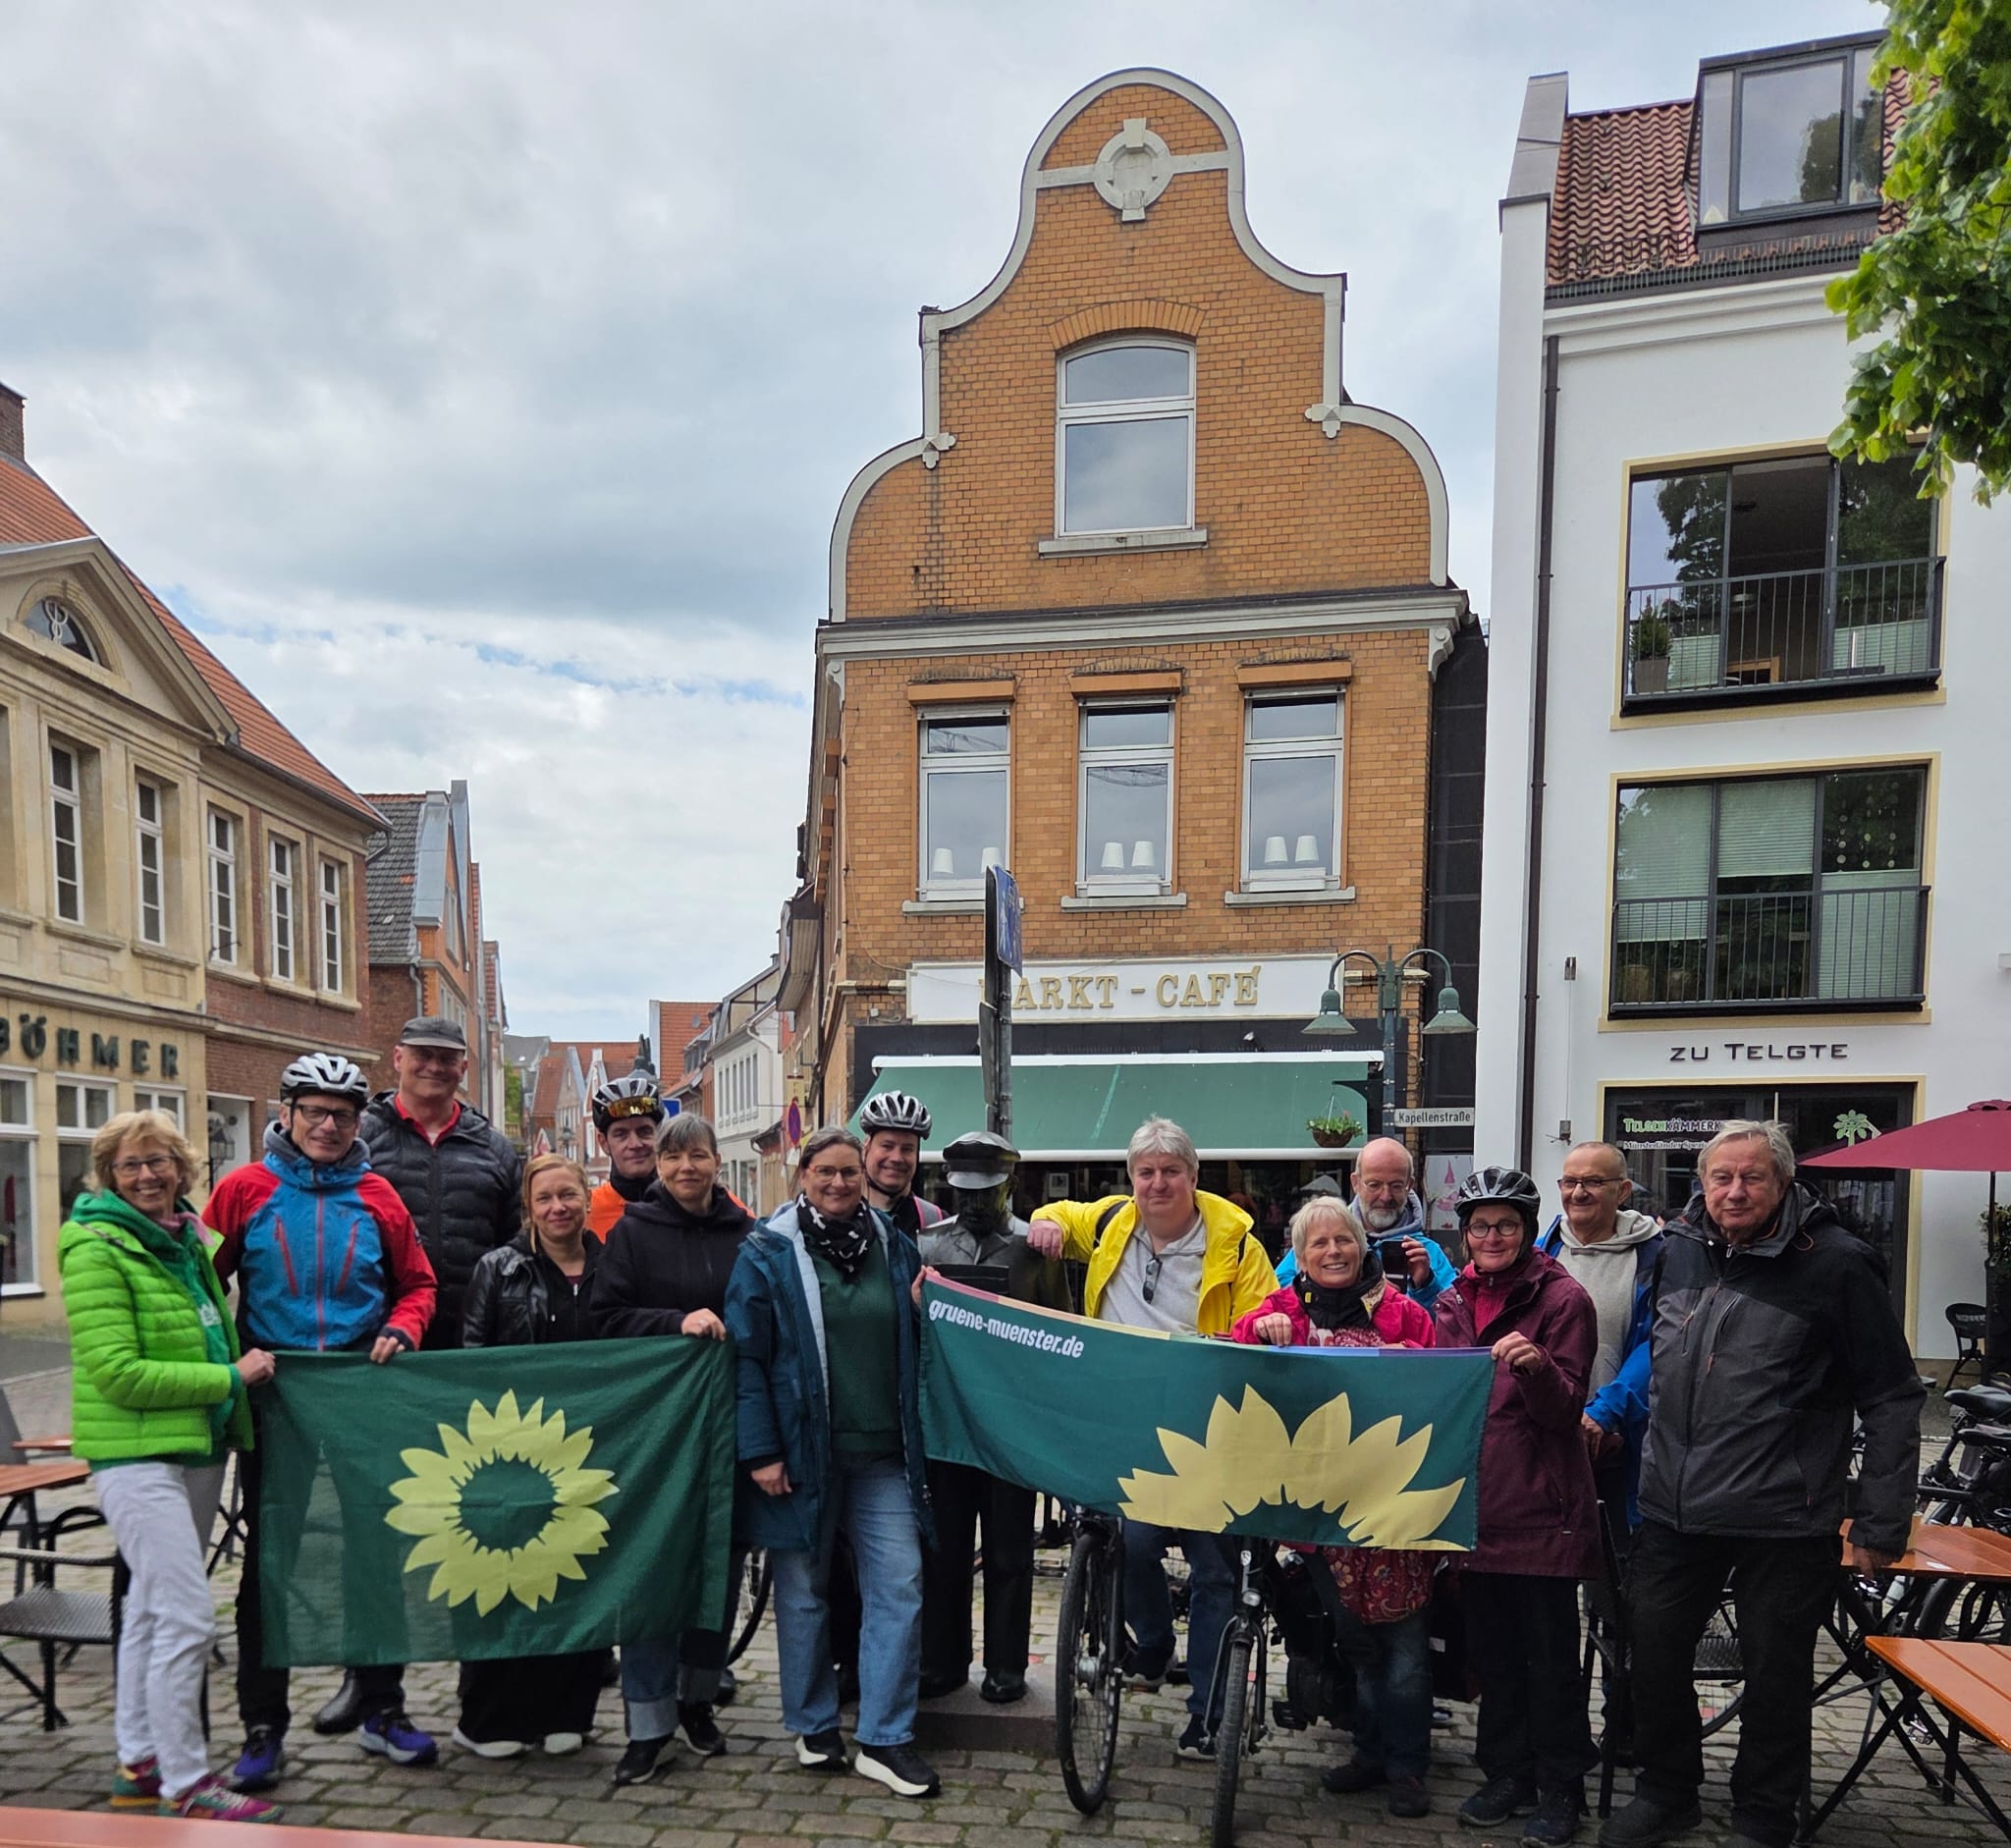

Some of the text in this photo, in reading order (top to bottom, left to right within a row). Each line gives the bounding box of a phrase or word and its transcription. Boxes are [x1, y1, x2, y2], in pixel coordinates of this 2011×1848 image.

[978, 975, 1117, 1009] ARKT
[1156, 965, 1261, 1006] CAFÉ
[1724, 1043, 1848, 1060] TELGTE
[1398, 1111, 1471, 1125] Kapellenstraße
[928, 1299, 1085, 1359] gruene-muenster.de
